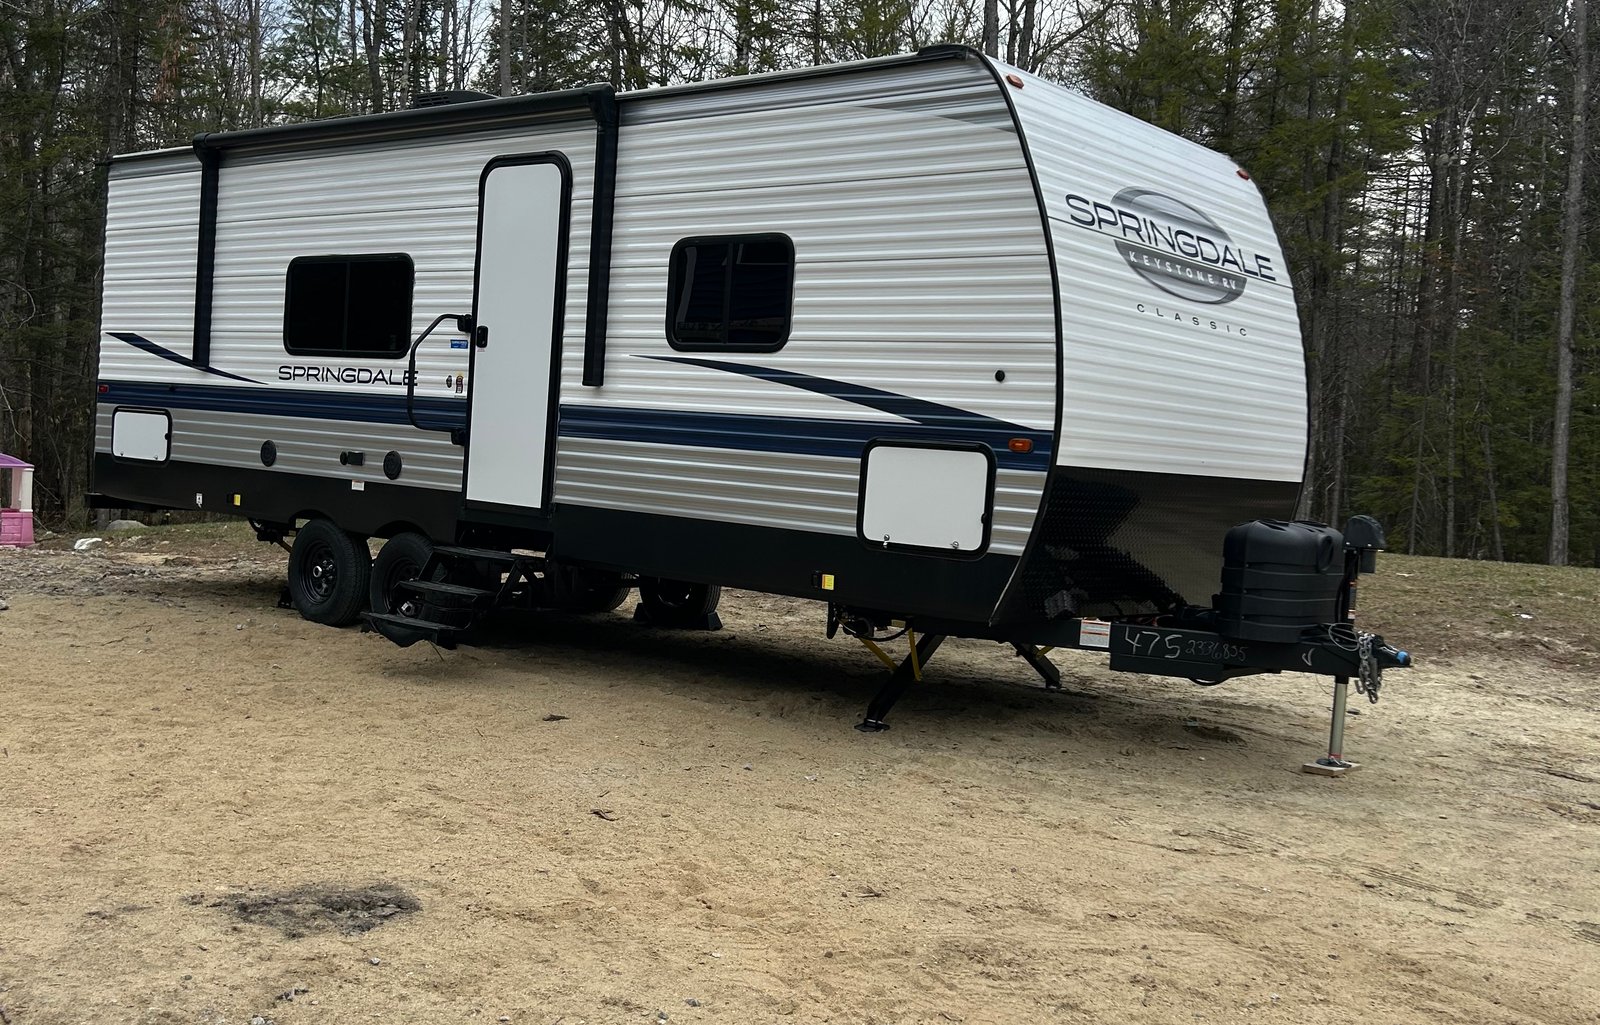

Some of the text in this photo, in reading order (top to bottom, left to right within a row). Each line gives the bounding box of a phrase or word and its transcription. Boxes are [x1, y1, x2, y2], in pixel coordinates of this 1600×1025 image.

[1065, 193, 1277, 281] SPRINGDALE
[1128, 250, 1237, 290] KEYSTONE RV
[1136, 303, 1247, 336] CLASSIC
[278, 365, 419, 386] SPRINGDALE
[1124, 626, 1183, 659] 475
